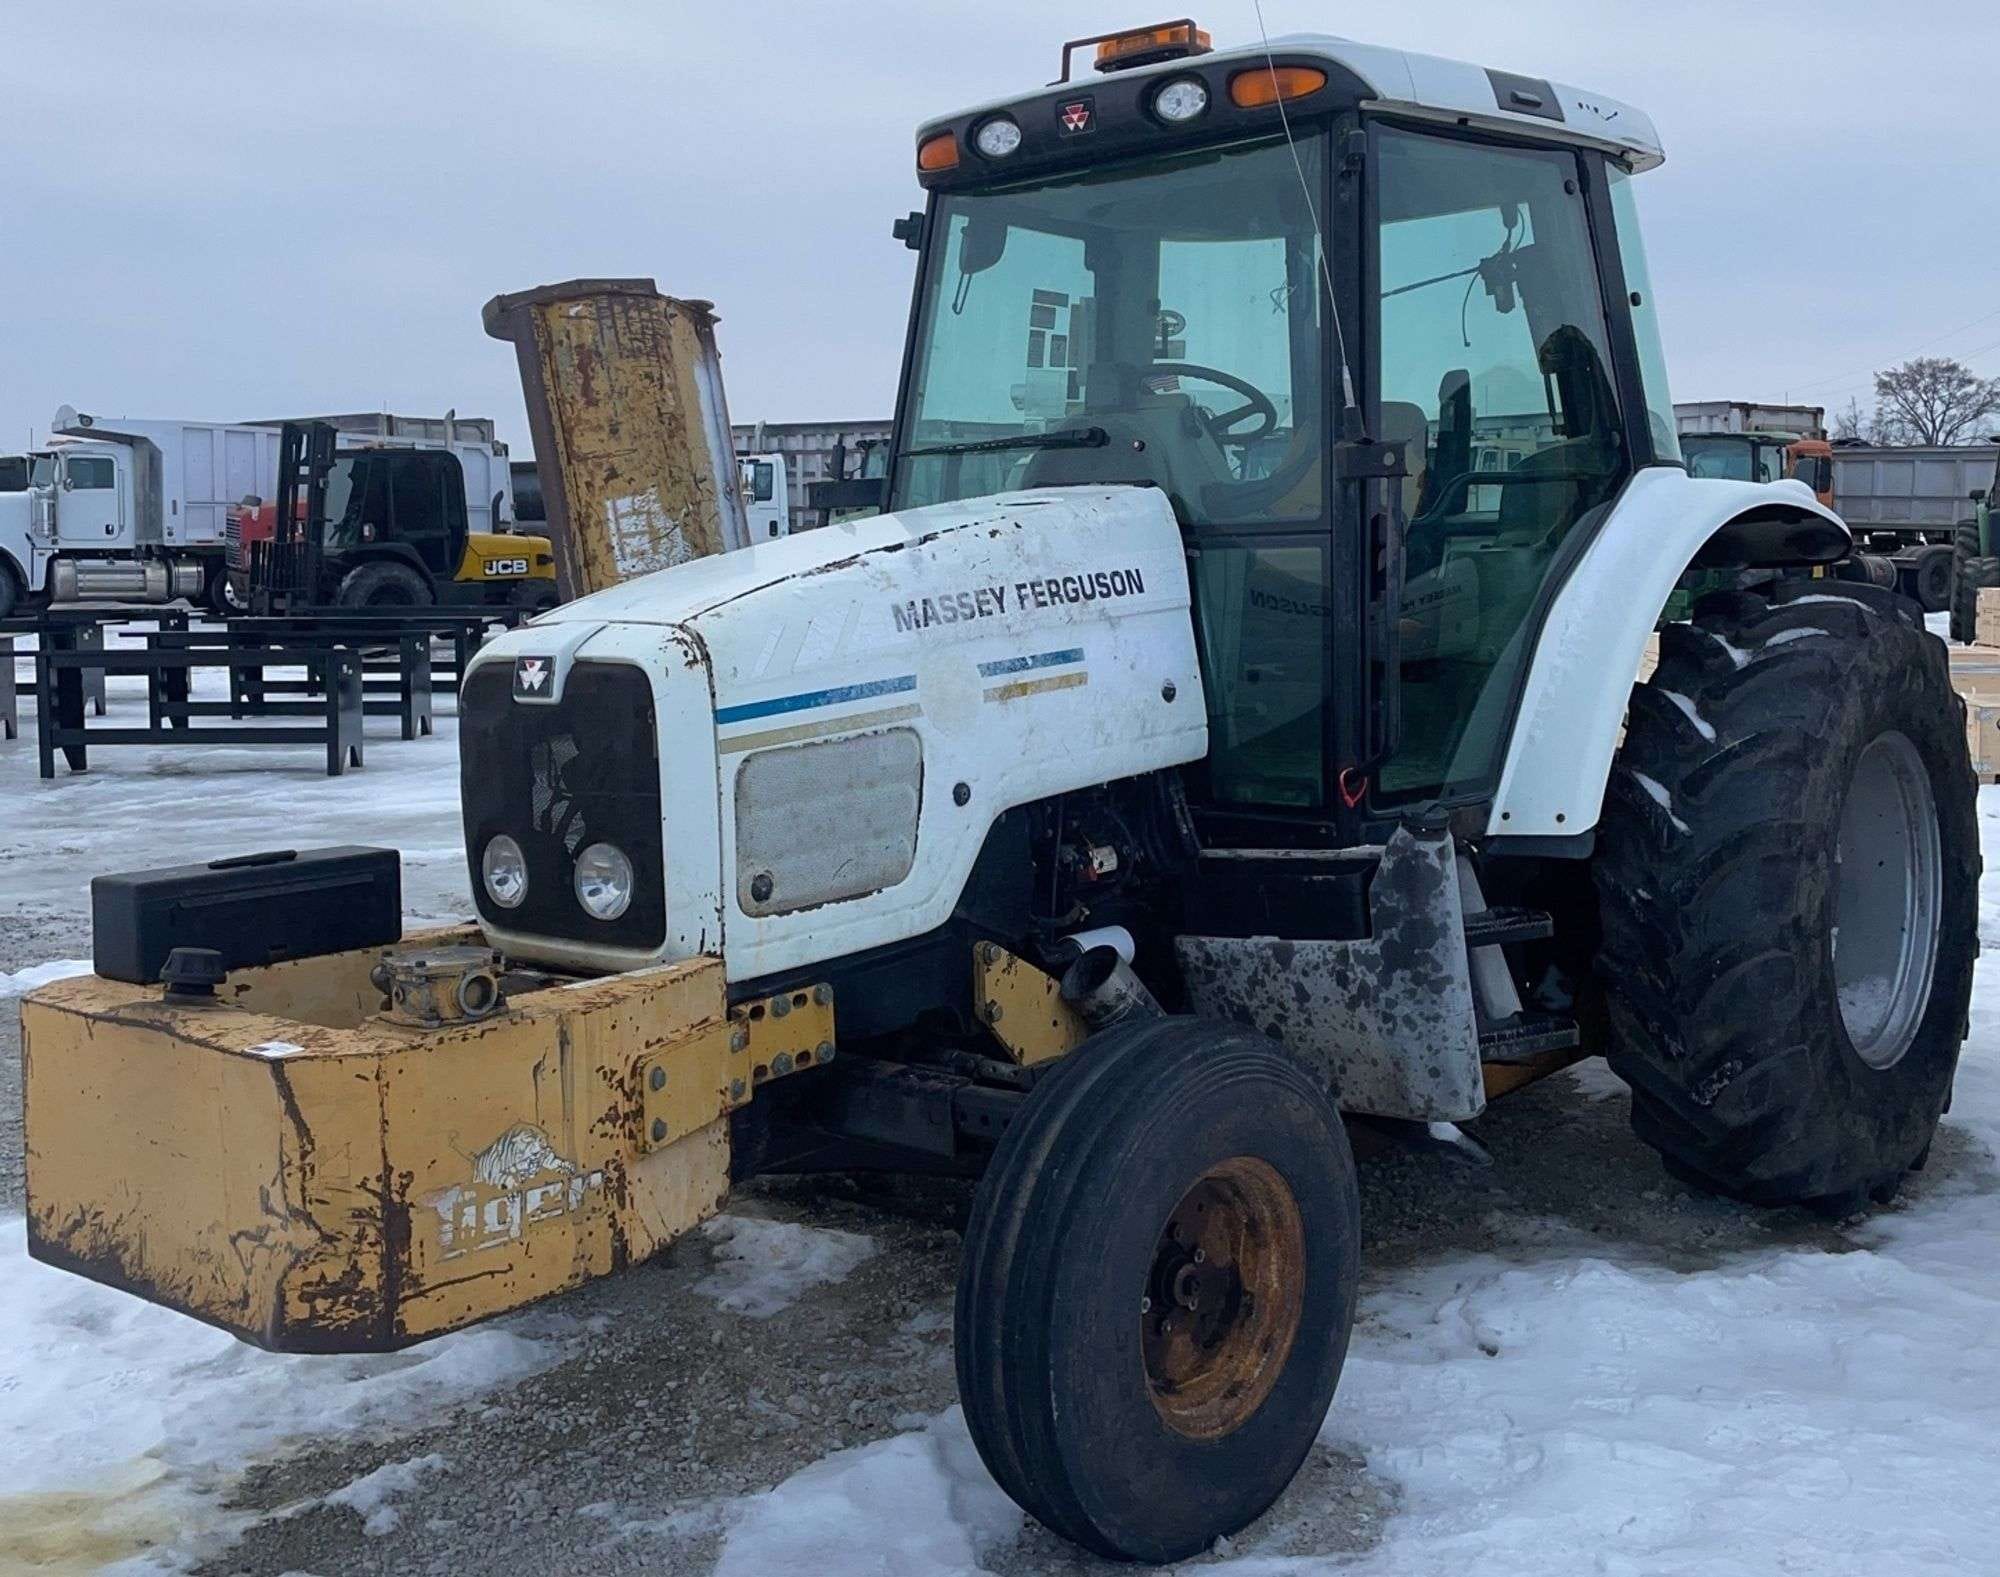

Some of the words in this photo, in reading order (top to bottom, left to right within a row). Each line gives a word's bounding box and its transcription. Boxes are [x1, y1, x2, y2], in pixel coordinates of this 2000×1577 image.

[484, 559, 528, 576] JCB
[891, 586, 1006, 633] MASSEY
[1014, 568, 1146, 611] FERGUSON
